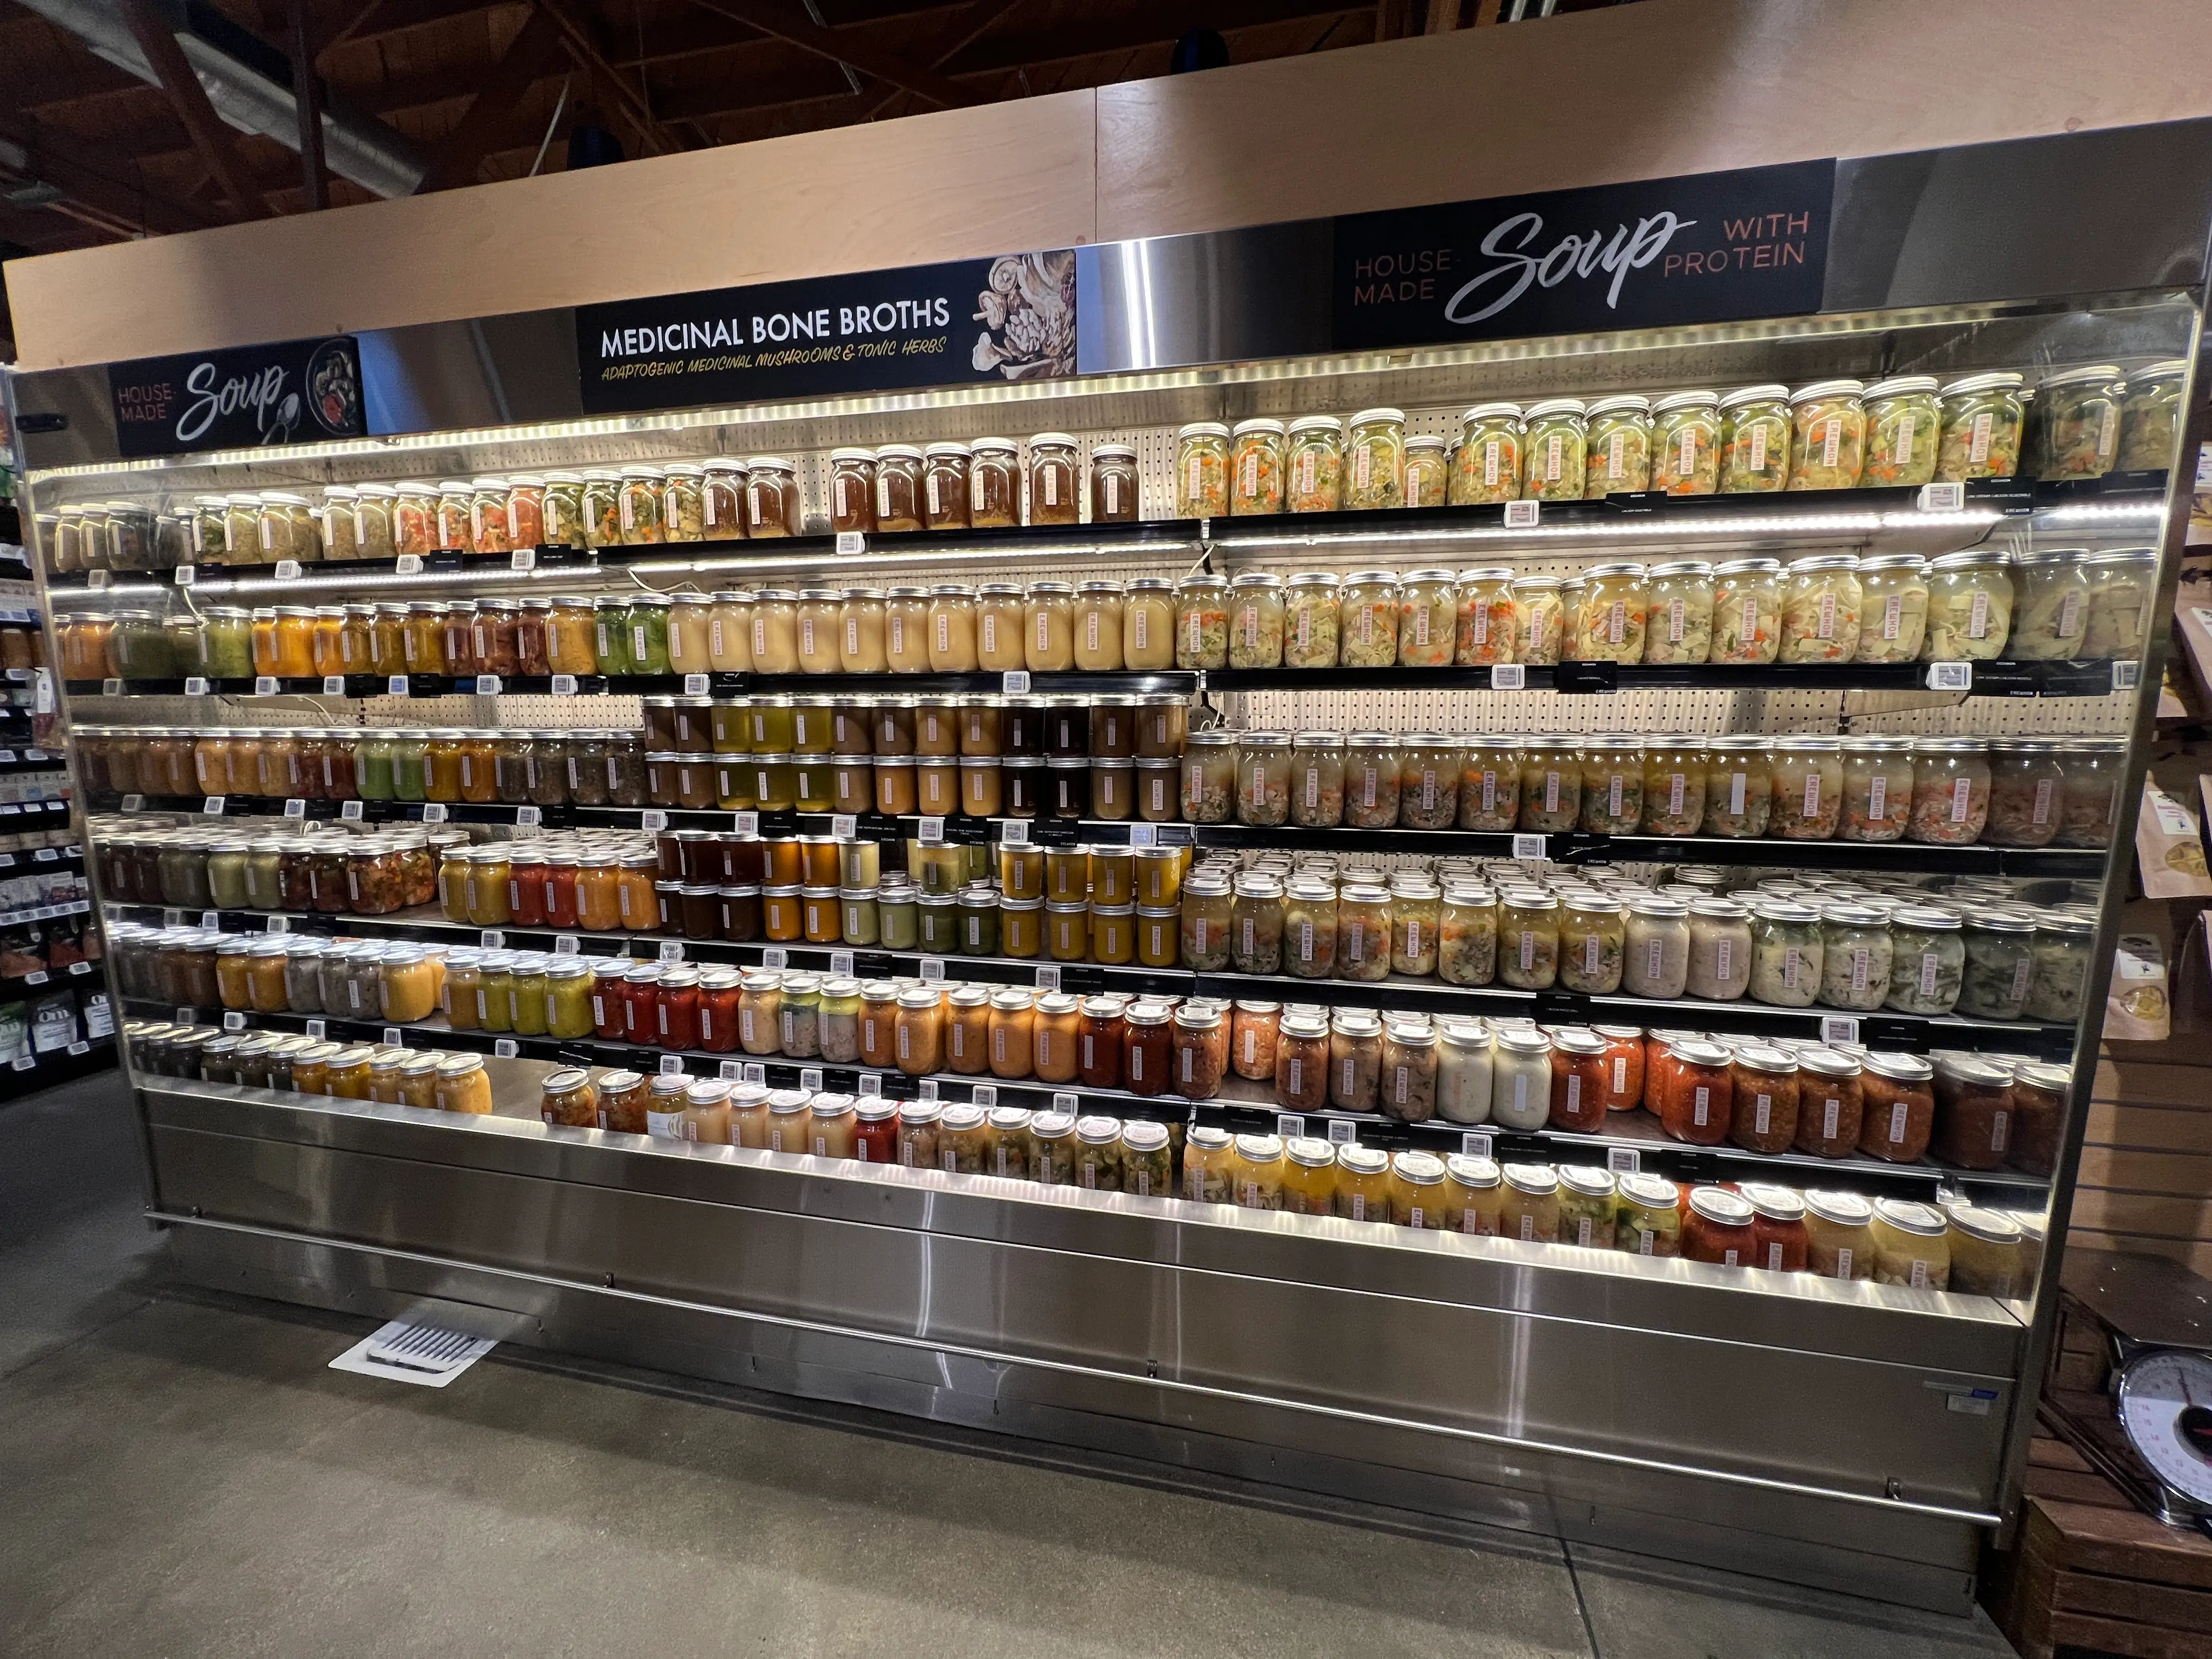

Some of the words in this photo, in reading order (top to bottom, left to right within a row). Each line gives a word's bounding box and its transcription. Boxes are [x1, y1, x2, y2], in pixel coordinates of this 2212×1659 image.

[1723, 211, 1810, 241] WITH
[1444, 211, 1697, 324] Soup
[1663, 240, 1805, 278] PROTEIN
[1354, 278, 1435, 307] MADE
[601, 318, 743, 358] MEDICINAL
[752, 308, 830, 344] BONE
[840, 297, 950, 335] BROTHS
[601, 360, 684, 381] ADAPTOGENIC
[687, 354, 753, 373] MEDICINAL
[755, 344, 842, 368] MUSHROOMS
[842, 343, 856, 361] &
[857, 339, 897, 358] TONIC
[901, 336, 947, 356] HERBS
[120, 403, 167, 422] MADE
[176, 362, 290, 441] Soup
[1611, 435, 1621, 477] EREWHON
[1683, 430, 1694, 473] EREWHON
[1753, 425, 1764, 470] EREWHON
[1826, 421, 1838, 465] EREWHON
[1898, 417, 1911, 463] EREWHON
[1974, 414, 1990, 461] EREWHON
[1248, 455, 1256, 495] EREWHON
[1304, 453, 1313, 492] EREWHON
[1359, 446, 1368, 487] EREWHON
[1487, 443, 1497, 484] EREWHON
[1550, 436, 1560, 479] EREWHON
[974, 472, 983, 509] EREWHON
[1408, 469, 1417, 507] EREWHON
[1248, 608, 1256, 646] EREWHON
[1363, 607, 1371, 644] EREWHON
[1419, 607, 1427, 644] EREWHON
[1476, 603, 1485, 643] EREWHON
[1532, 610, 1541, 647] EREWHON
[1612, 601, 1622, 641] EREWHON
[1672, 600, 1681, 640] EREWHON
[1743, 599, 1754, 640] EREWHON
[1821, 594, 1832, 637] EREWHON
[1887, 596, 1898, 638] EREWHON
[1972, 592, 1985, 636] EREWHON
[636, 627, 645, 659] EREWHON
[1308, 770, 1316, 806] EREWHON
[1365, 769, 1375, 806] EREWHON
[1424, 771, 1433, 809] EREWHON
[1484, 772, 1493, 809] EREWHON
[1548, 773, 1558, 811] EREWHON
[1611, 776, 1620, 815] EREWHON
[1672, 775, 1683, 814] EREWHON
[1806, 776, 1818, 816] EREWHON
[1872, 778, 1883, 819] EREWHON
[1954, 779, 1968, 821] EREWHON
[1303, 924, 1311, 960] EREWHON
[1352, 924, 1361, 959] EREWHON
[1409, 922, 1418, 957] EREWHON
[1522, 932, 1532, 968] EREWHON
[1587, 936, 1597, 973] EREWHON
[1650, 940, 1660, 978] EREWHON
[1719, 941, 1729, 978] EREWHON
[1786, 949, 1797, 987] EREWHON
[1854, 950, 1866, 990] EREWHON
[1923, 955, 1936, 994] EREWHON
[1615, 1058, 1624, 1092] EREWHON
[1697, 1088, 1707, 1125] EREWHON
[1758, 1095, 1769, 1132] EREWHON
[1826, 1100, 1837, 1137] EREWHON
[1892, 1104, 1905, 1142] EREWHON
[1413, 1209, 1421, 1228] EREW
[1914, 1261, 1925, 1288] EREWH
